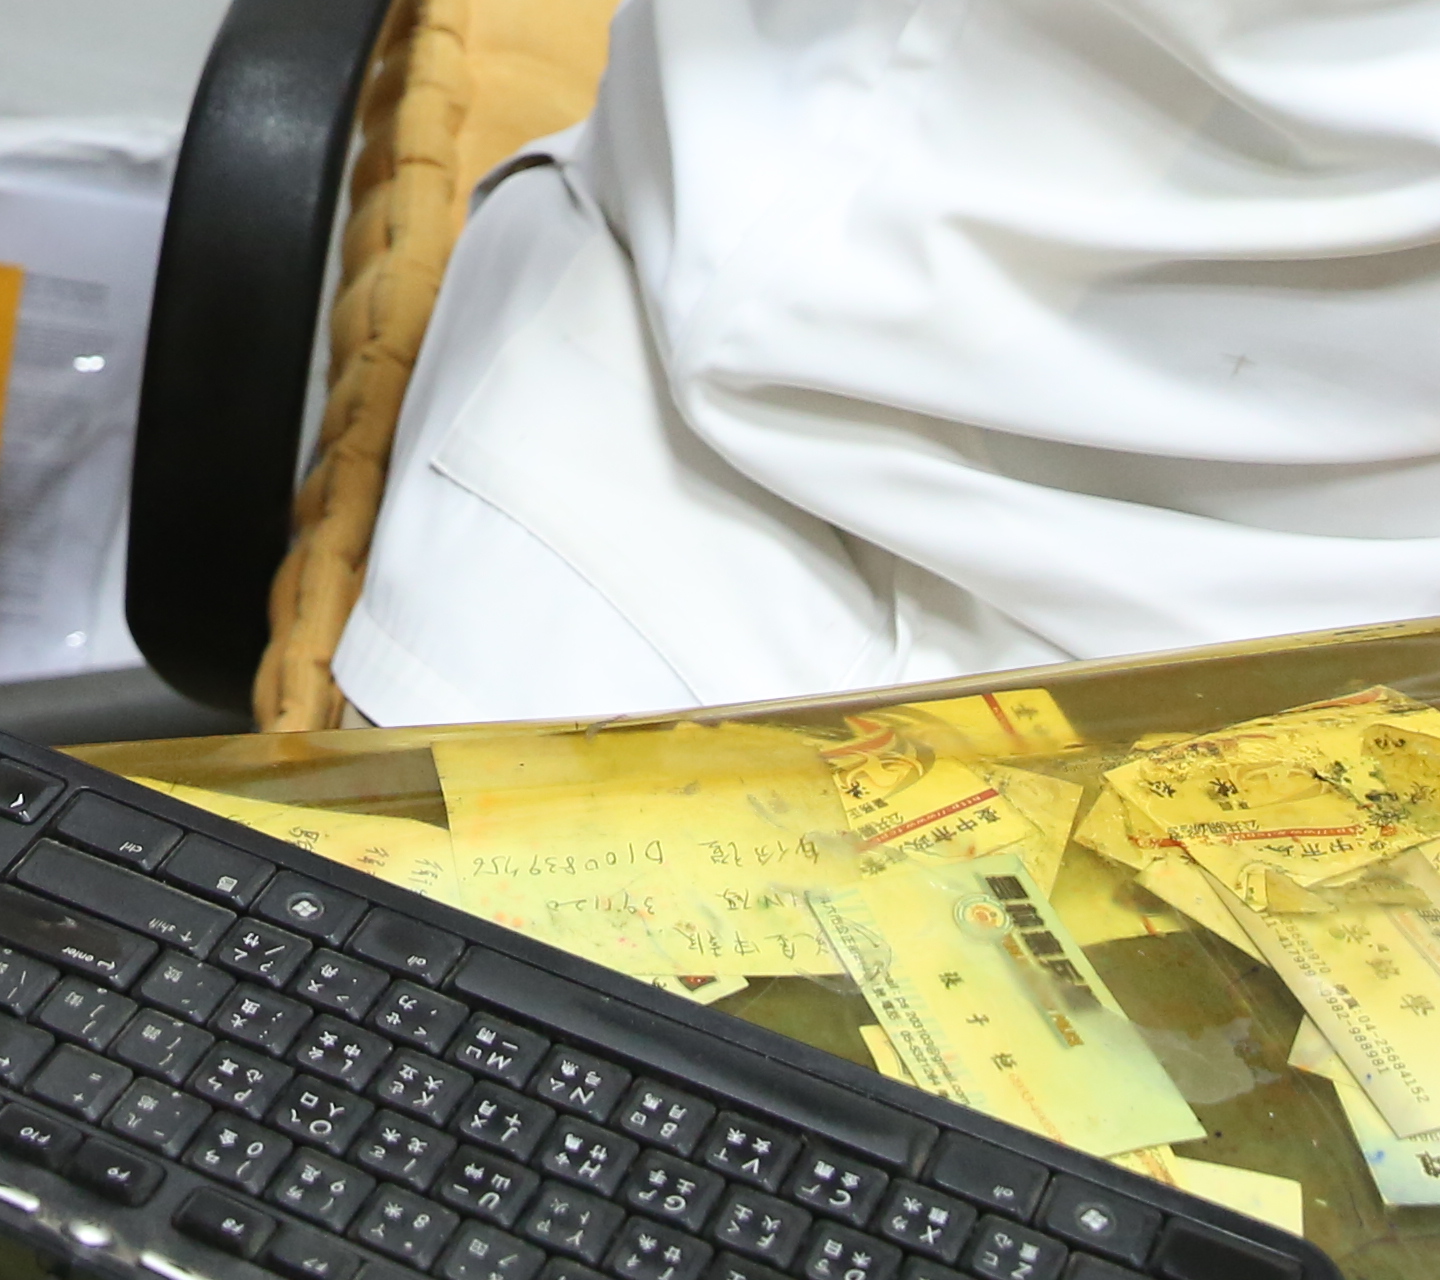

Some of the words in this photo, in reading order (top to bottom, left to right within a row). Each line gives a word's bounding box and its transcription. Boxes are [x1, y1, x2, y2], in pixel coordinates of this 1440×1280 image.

[118, 841, 145, 859] ctrl
[148, 918, 180, 936] shift
[61, 945, 96, 966] enter
[406, 955, 427, 967] alt
[340, 1058, 354, 1073] L
[486, 1051, 512, 1070] M
[233, 1088, 253, 1104] P
[412, 1091, 434, 1107] K
[569, 1086, 595, 1105] N
[19, 1126, 51, 1144] F10
[309, 1119, 332, 1135] O
[500, 1126, 519, 1142] J
[660, 1122, 678, 1139] B
[246, 1141, 264, 1156] 0
[107, 1167, 131, 1181] F9
[578, 1160, 602, 1179] H
[741, 1158, 760, 1175] V
[330, 1179, 346, 1193] 9
[992, 1185, 1014, 1199] alt
[478, 1192, 500, 1210] U
[663, 1195, 686, 1214] G
[828, 1189, 851, 1208] C
[221, 1218, 245, 1234] F8
[413, 1214, 430, 1229] 8
[565, 1229, 584, 1247] Y
[756, 1233, 775, 1250] F
[302, 1258, 328, 1274] F7
